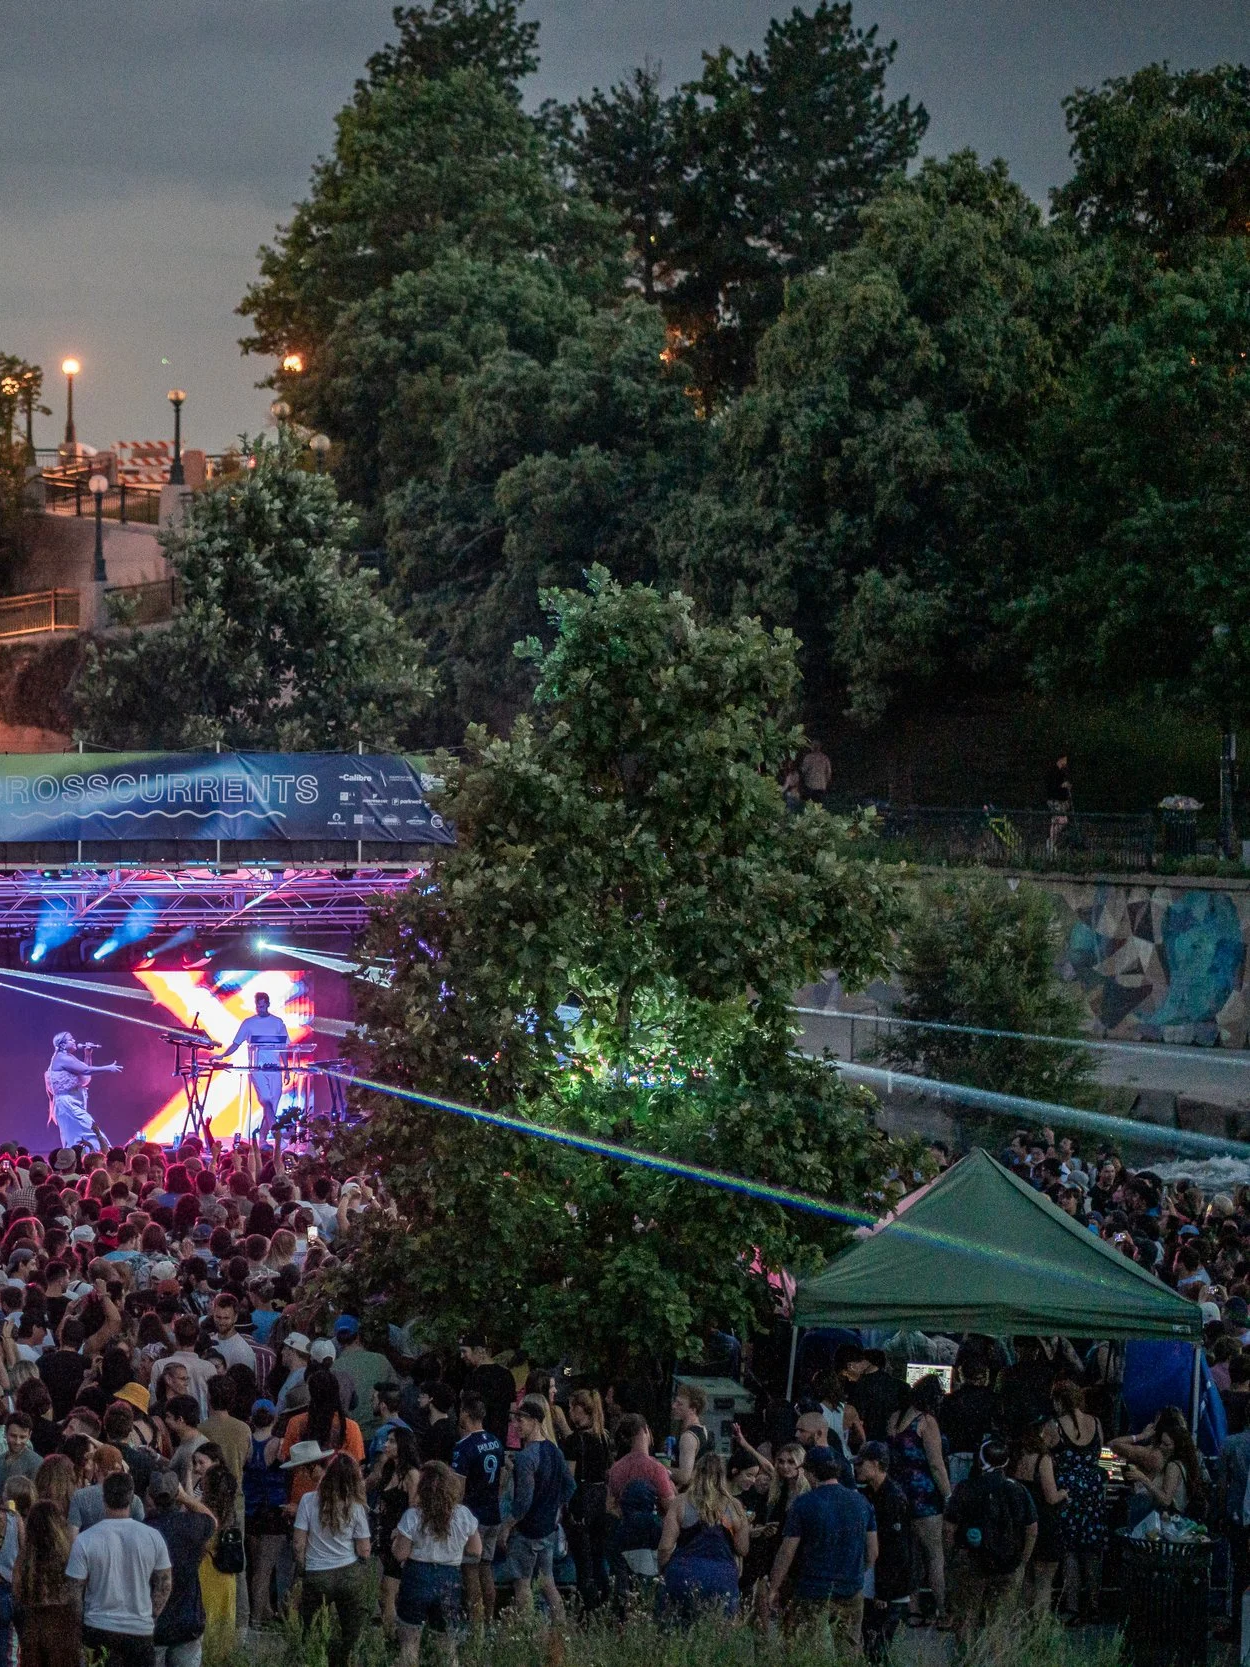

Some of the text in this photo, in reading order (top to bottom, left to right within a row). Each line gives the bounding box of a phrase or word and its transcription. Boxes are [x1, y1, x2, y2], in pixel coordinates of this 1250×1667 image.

[343, 774, 372, 782] Calibre
[477, 1440, 499, 1453] PULIDO
[484, 1454, 497, 1484] 9
